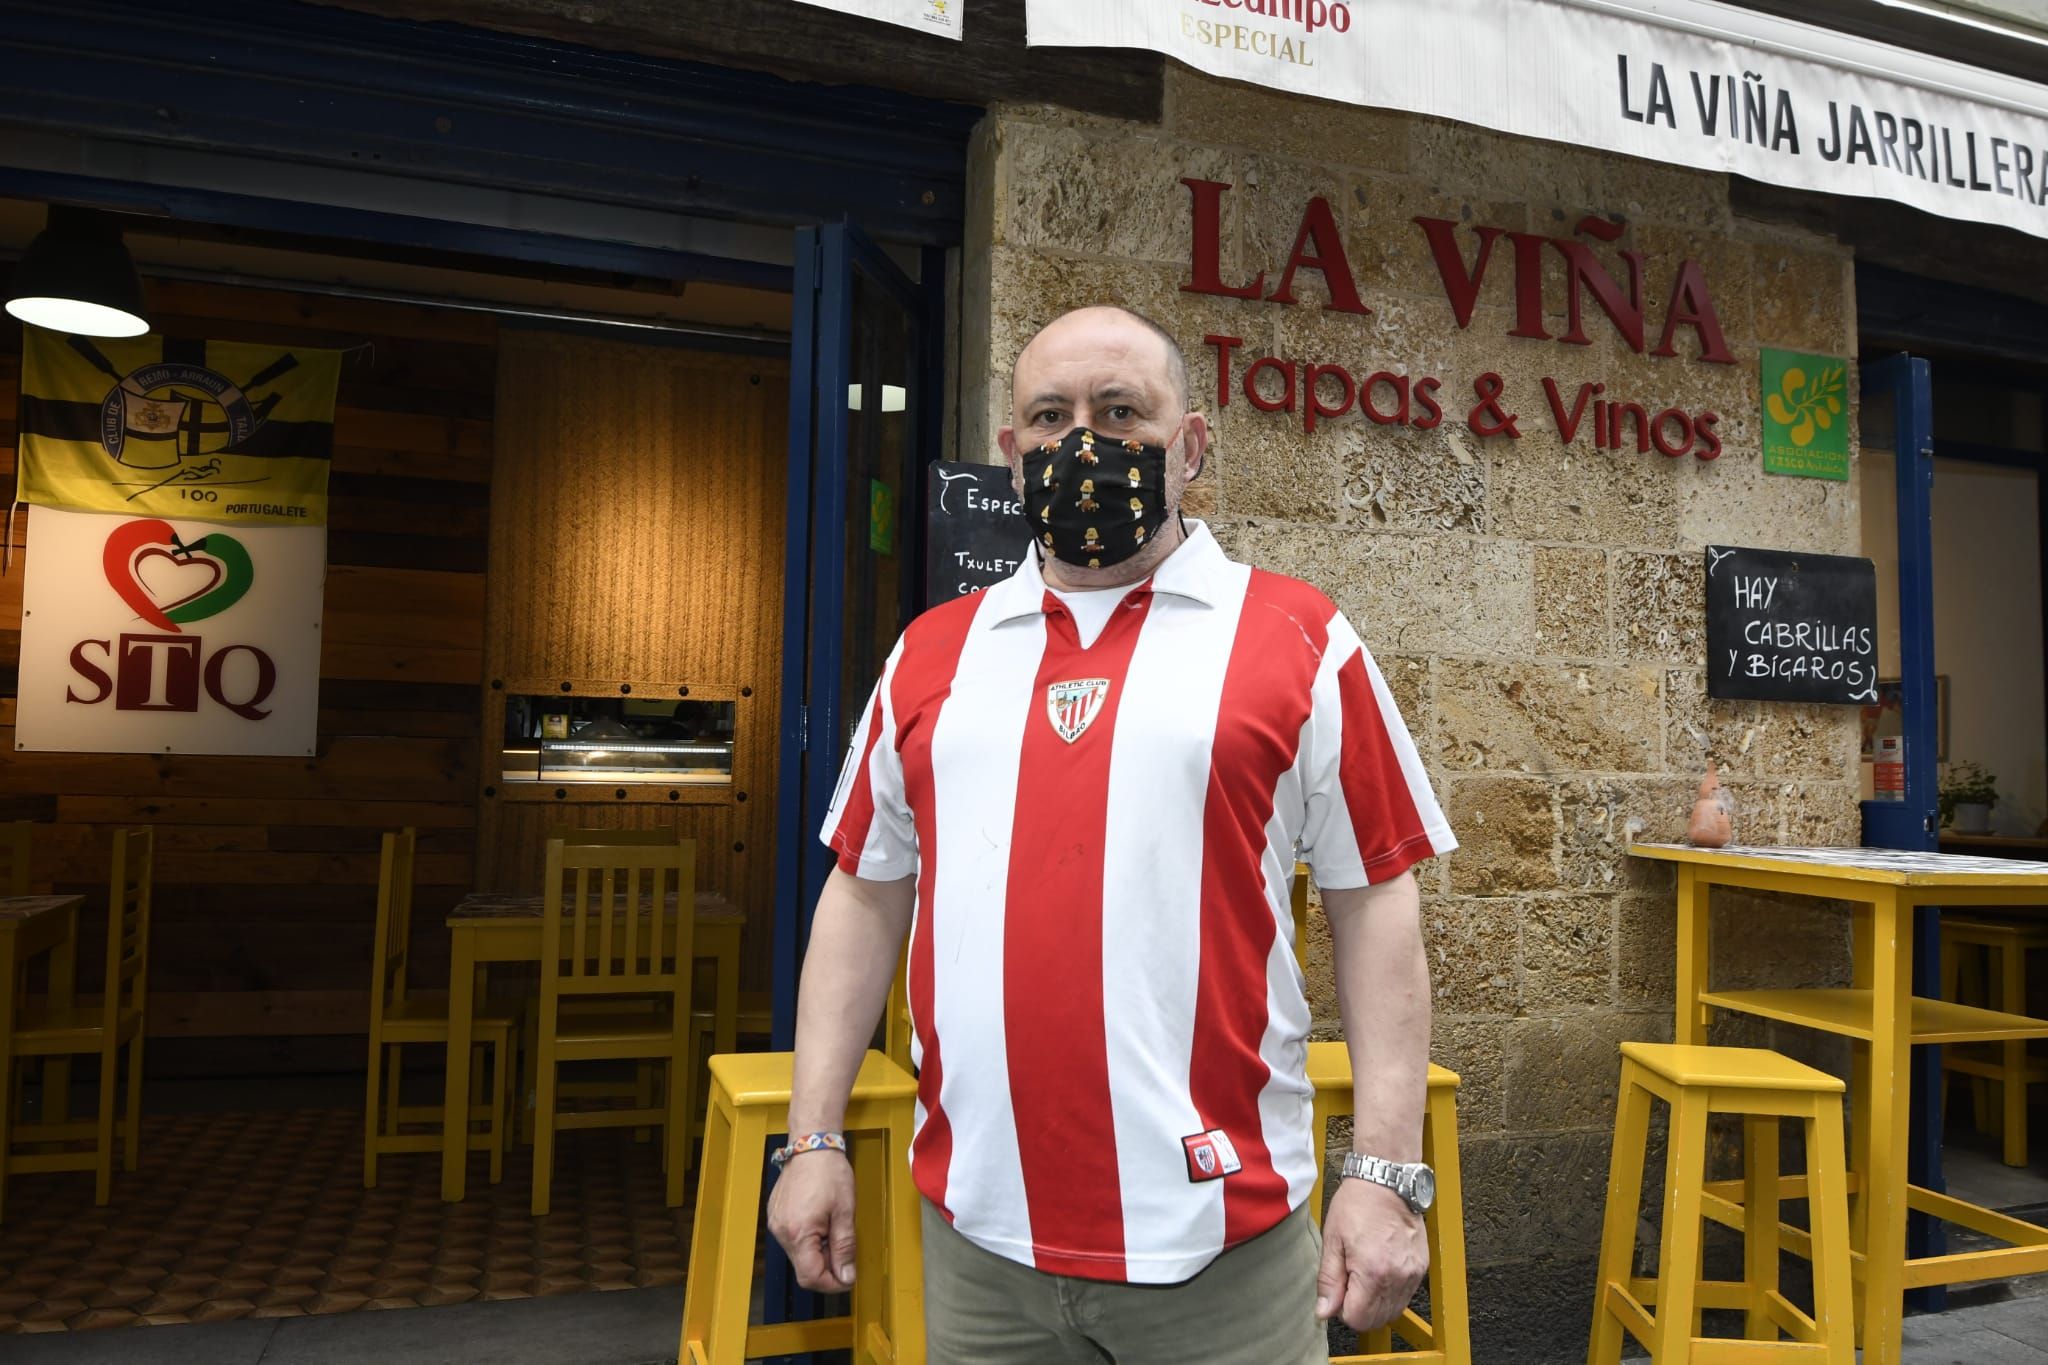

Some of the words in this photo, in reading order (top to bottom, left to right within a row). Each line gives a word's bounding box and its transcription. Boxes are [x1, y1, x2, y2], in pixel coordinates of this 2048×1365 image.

[1180, 11, 1314, 66] ESPECIAL
[1617, 54, 1677, 129] LA
[1690, 70, 1800, 155] VIÑA
[1179, 177, 1373, 316] LA
[1412, 214, 1739, 366] VIÑA
[139, 370, 170, 387] REMO
[108, 401, 121, 415] DE
[1204, 334, 1443, 434] Tapas
[1467, 371, 1523, 439] &
[1541, 376, 1723, 461] Vinos
[108, 417, 120, 445] CLUB
[181, 489, 218, 502] 100
[967, 488, 1026, 516] ESPEC
[225, 504, 308, 518] PORTUGALETE
[958, 582, 989, 594] CO
[1734, 575, 1778, 609] HAY
[65, 636, 277, 721] STQ
[1051, 682, 1084, 690] ATHLETIC
[1059, 723, 1085, 739] BILBAO
